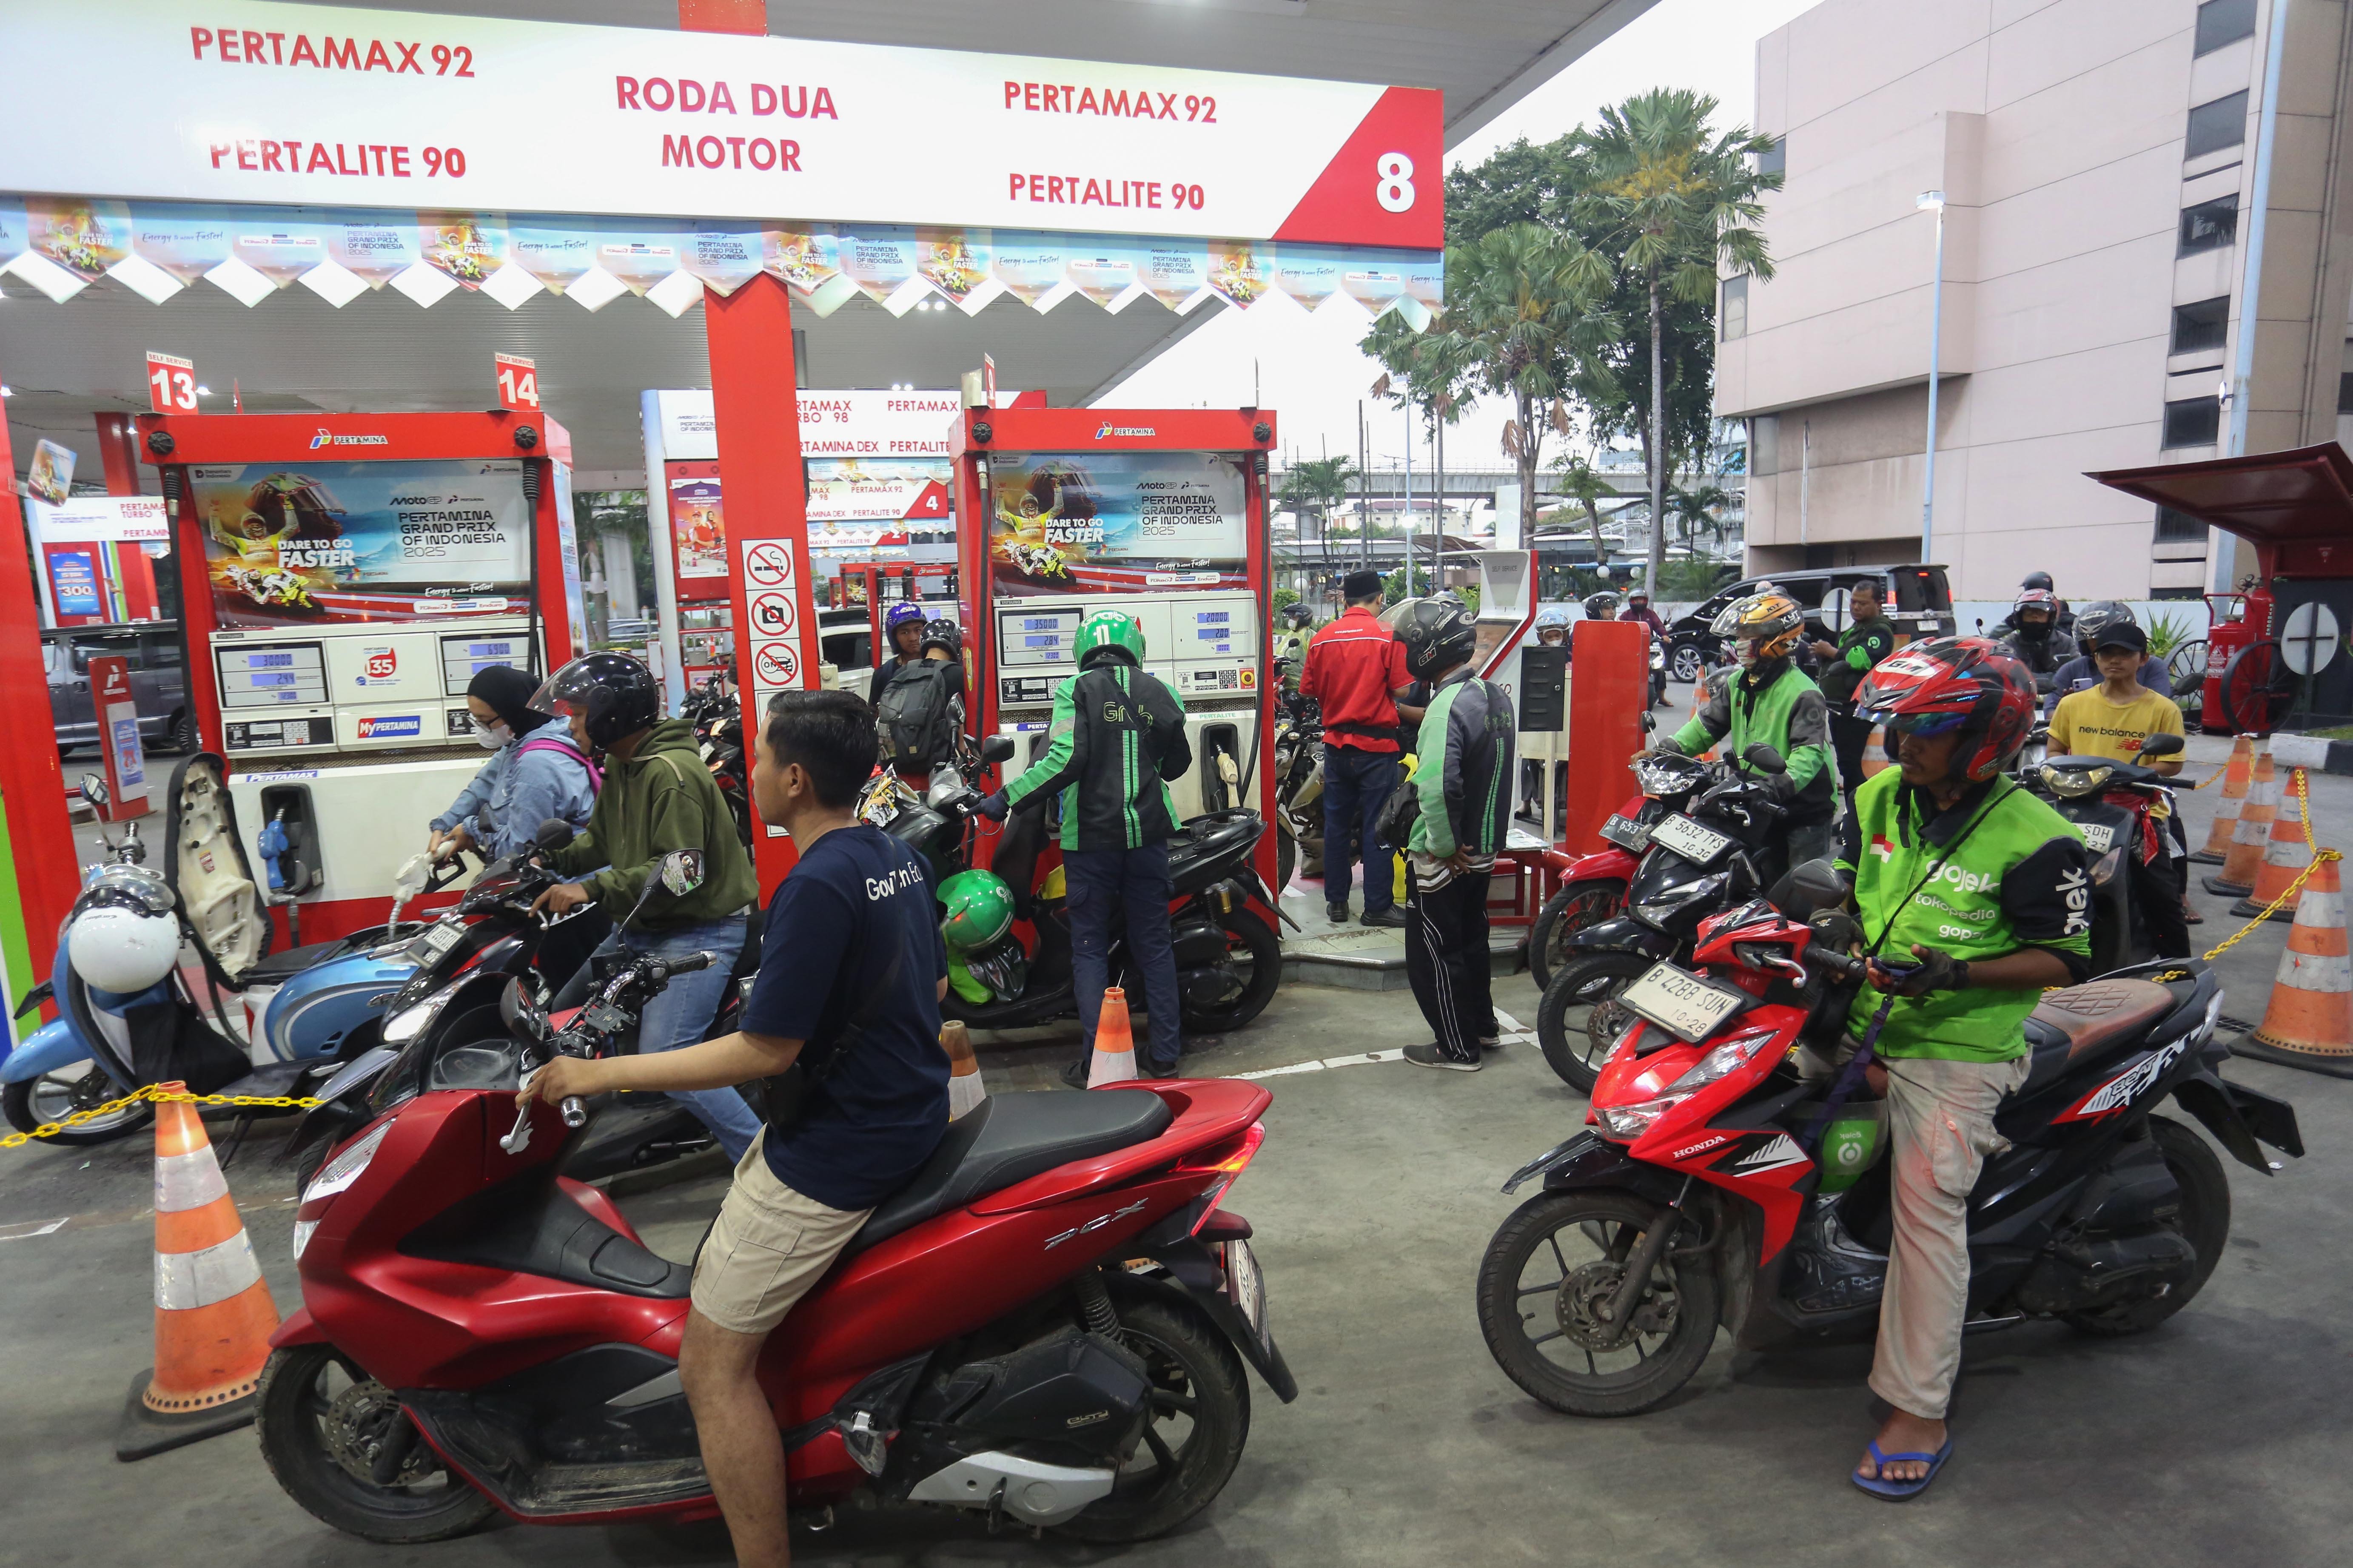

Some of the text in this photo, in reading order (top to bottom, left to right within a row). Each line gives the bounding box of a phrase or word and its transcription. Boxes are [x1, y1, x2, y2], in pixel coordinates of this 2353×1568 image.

[191, 26, 475, 78] PERTAMAX 92
[616, 76, 838, 120] RODA DUA
[1004, 81, 1216, 123] PERTAMAX 92
[210, 139, 466, 178] PERTALITE 90
[662, 134, 802, 172] MOTOR
[1376, 151, 1416, 213] 8
[1009, 173, 1204, 210] PERTALITE 90
[464, 246, 494, 254] FASTER
[999, 256, 1020, 267] Energy
[1281, 268, 1301, 277] Energy
[1411, 275, 1430, 284] Energy
[148, 353, 192, 367] SELF SERVICE
[512, 358, 534, 367] SERVICE
[151, 369, 197, 409] 13
[499, 369, 539, 407] 14
[888, 400, 958, 412] PERTAMAX
[834, 413, 849, 423] 98
[1114, 428, 1155, 436] PERTAMINA
[334, 436, 388, 444] PERTAMINA
[857, 441, 879, 452] DEX
[890, 441, 950, 452] PERTALITE
[926, 496, 938, 510] 4
[1142, 495, 1215, 504] PERTAMINA
[399, 510, 493, 523] PERTAMINA
[1142, 506, 1216, 515] GRAND PRIX
[1045, 518, 1104, 527] DARE TO GO
[1142, 515, 1223, 525] OF INDONESIA
[401, 522, 496, 534] GRAND PRIX
[1142, 526, 1175, 535] 2025
[402, 533, 506, 546] OF INDONESIA
[1044, 527, 1104, 544] FASTER
[278, 539, 353, 550] DARE TO GO
[404, 546, 446, 557] 2025
[279, 550, 355, 568] FASTER
[1155, 558, 1210, 571] Energy Faster!
[425, 582, 493, 598] Energy Faster!
[1081, 611, 1126, 627] Grab
[1206, 612, 1228, 622] 20000
[1780, 609, 1799, 625] KYT
[2265, 603, 2274, 636] NITROGEN
[1034, 619, 1058, 629] 35000
[1216, 629, 1228, 638] 2.00
[1044, 636, 1058, 645] 2.84
[487, 643, 510, 655] 6900
[366, 659, 394, 674] 135
[1888, 660, 1924, 672] GM
[1104, 701, 1154, 726] Grb
[359, 720, 419, 737] MyPERTAMINA
[2079, 726, 2145, 738] new balance
[249, 771, 316, 783] PERTAMAX
[1609, 816, 1643, 835] B 653
[2084, 825, 2110, 839] SDH
[1665, 816, 1726, 849] B 5632 TYS
[1926, 859, 2001, 894] gojek
[1915, 892, 1996, 922] tokopedia
[1647, 968, 1732, 1016] B 4288 SUN
[1672, 1135, 1727, 1158] HONDA
[1044, 1197, 1149, 1251] PCX
